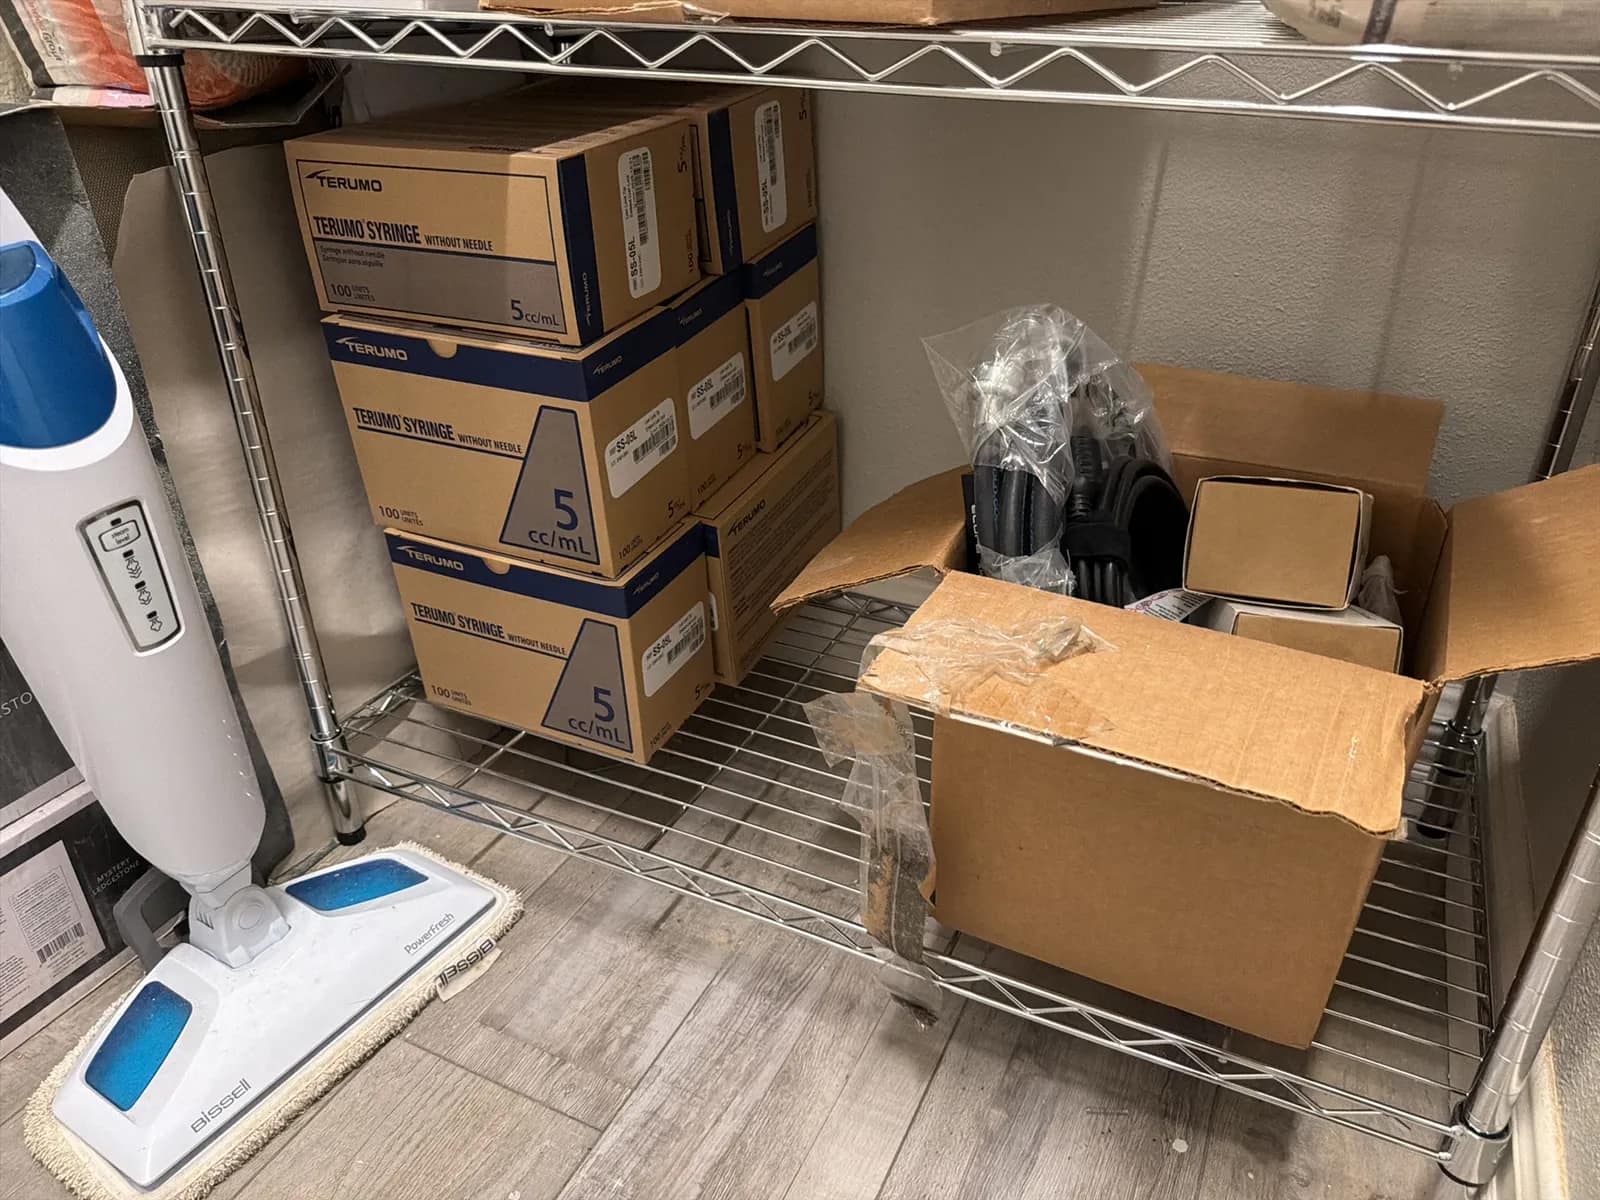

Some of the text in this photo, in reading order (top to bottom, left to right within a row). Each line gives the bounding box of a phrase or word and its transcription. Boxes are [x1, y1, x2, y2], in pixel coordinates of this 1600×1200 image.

[310, 171, 383, 192] TERUMO
[313, 216, 493, 251] TERUMO SYRINGE WITHOUT NEEDLE
[330, 283, 352, 297] 100
[341, 338, 408, 361] TERUMO
[353, 407, 523, 454] TERUMO SYRINGE WITHOUT NEEDLE
[379, 505, 400, 519] 100
[554, 488, 579, 530] 5
[728, 499, 767, 537] TERUMO
[528, 529, 592, 555] cc/mL
[400, 547, 464, 571] TERUMO
[411, 602, 567, 655] TERUMO SYRINGE WITHOUT NEEDLE
[431, 684, 451, 698] 100
[593, 686, 615, 722] 5
[0, 691, 33, 719] STO
[568, 717, 625, 744] cc/mL
[96, 858, 130, 884] MYSTERY
[404, 912, 455, 954] PowerFresh
